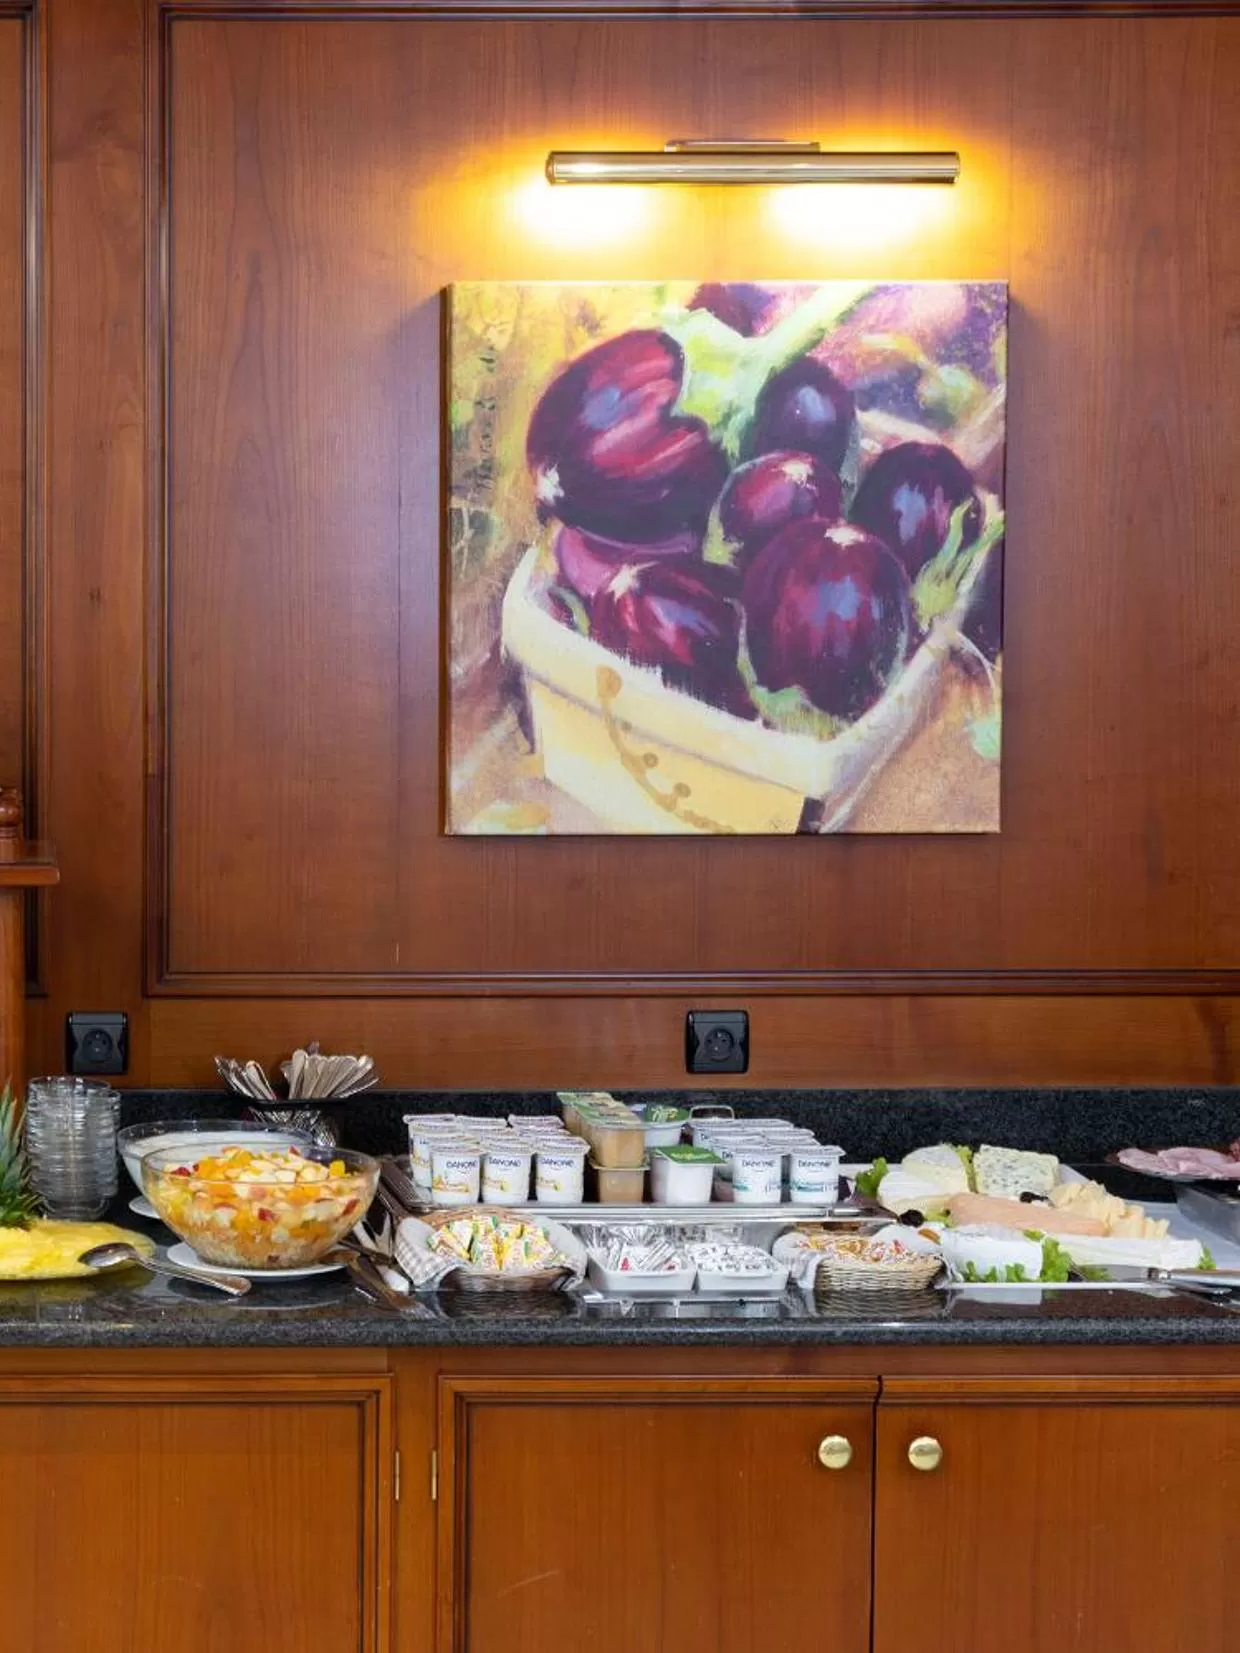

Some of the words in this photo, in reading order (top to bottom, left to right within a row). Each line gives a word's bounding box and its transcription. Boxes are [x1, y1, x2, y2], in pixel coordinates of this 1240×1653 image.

[489, 1156, 522, 1168] DANONE
[540, 1157, 575, 1168] DANONE
[741, 1159, 775, 1168] DANONE
[798, 1159, 832, 1168] DANONE
